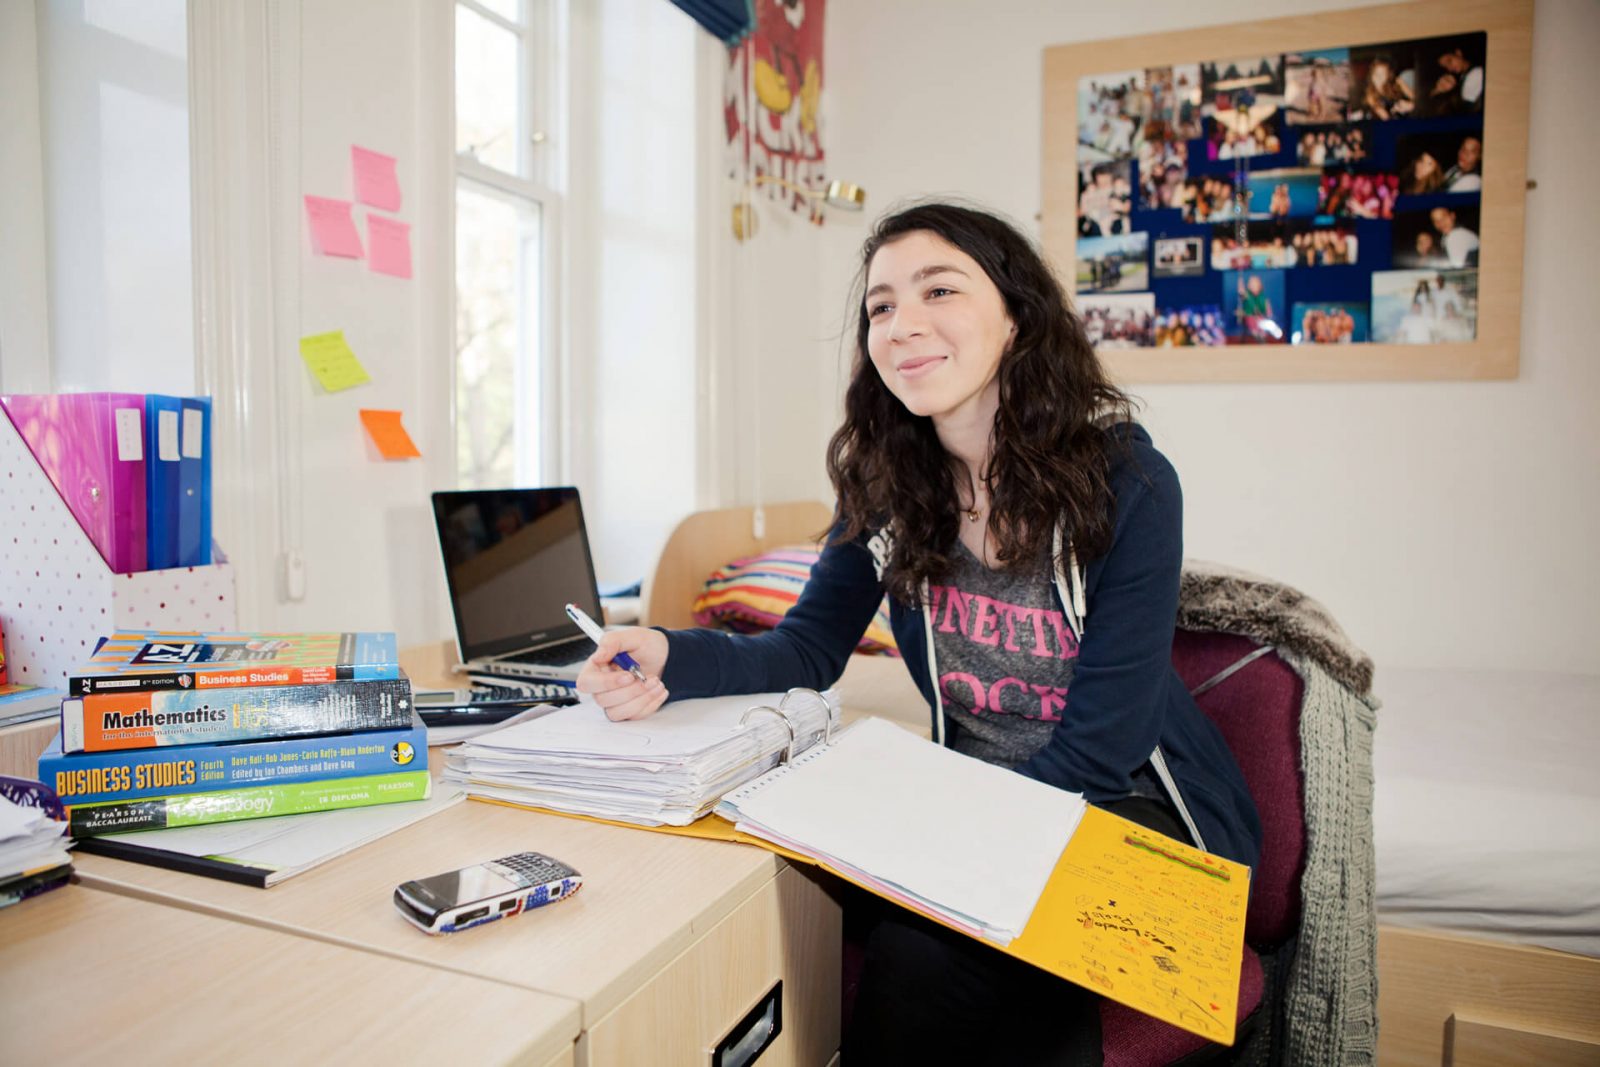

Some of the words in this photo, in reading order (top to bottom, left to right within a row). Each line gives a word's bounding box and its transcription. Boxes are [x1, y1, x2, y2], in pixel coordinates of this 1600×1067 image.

[199, 674, 248, 685] Business
[249, 673, 289, 683] Studies
[104, 704, 227, 729] Mathematics
[103, 731, 116, 740] for
[133, 727, 193, 738] international
[195, 724, 228, 733] student
[201, 760, 224, 770] Fourth
[231, 757, 247, 766] Dave
[231, 769, 253, 780] Edited
[255, 768, 264, 778] by
[265, 767, 276, 777] Ian
[276, 764, 309, 776] Chambers
[310, 762, 322, 772] and
[324, 761, 339, 771] Dave
[340, 759, 356, 770] Gray
[56, 765, 131, 797] BUSINESS
[135, 760, 196, 789] STUDIES
[201, 771, 225, 781] Edition
[378, 782, 415, 791] PEARSON
[332, 792, 370, 802] DIPLOMA
[94, 808, 145, 819] PEARSON
[86, 815, 153, 828] BACCALAUREATE
